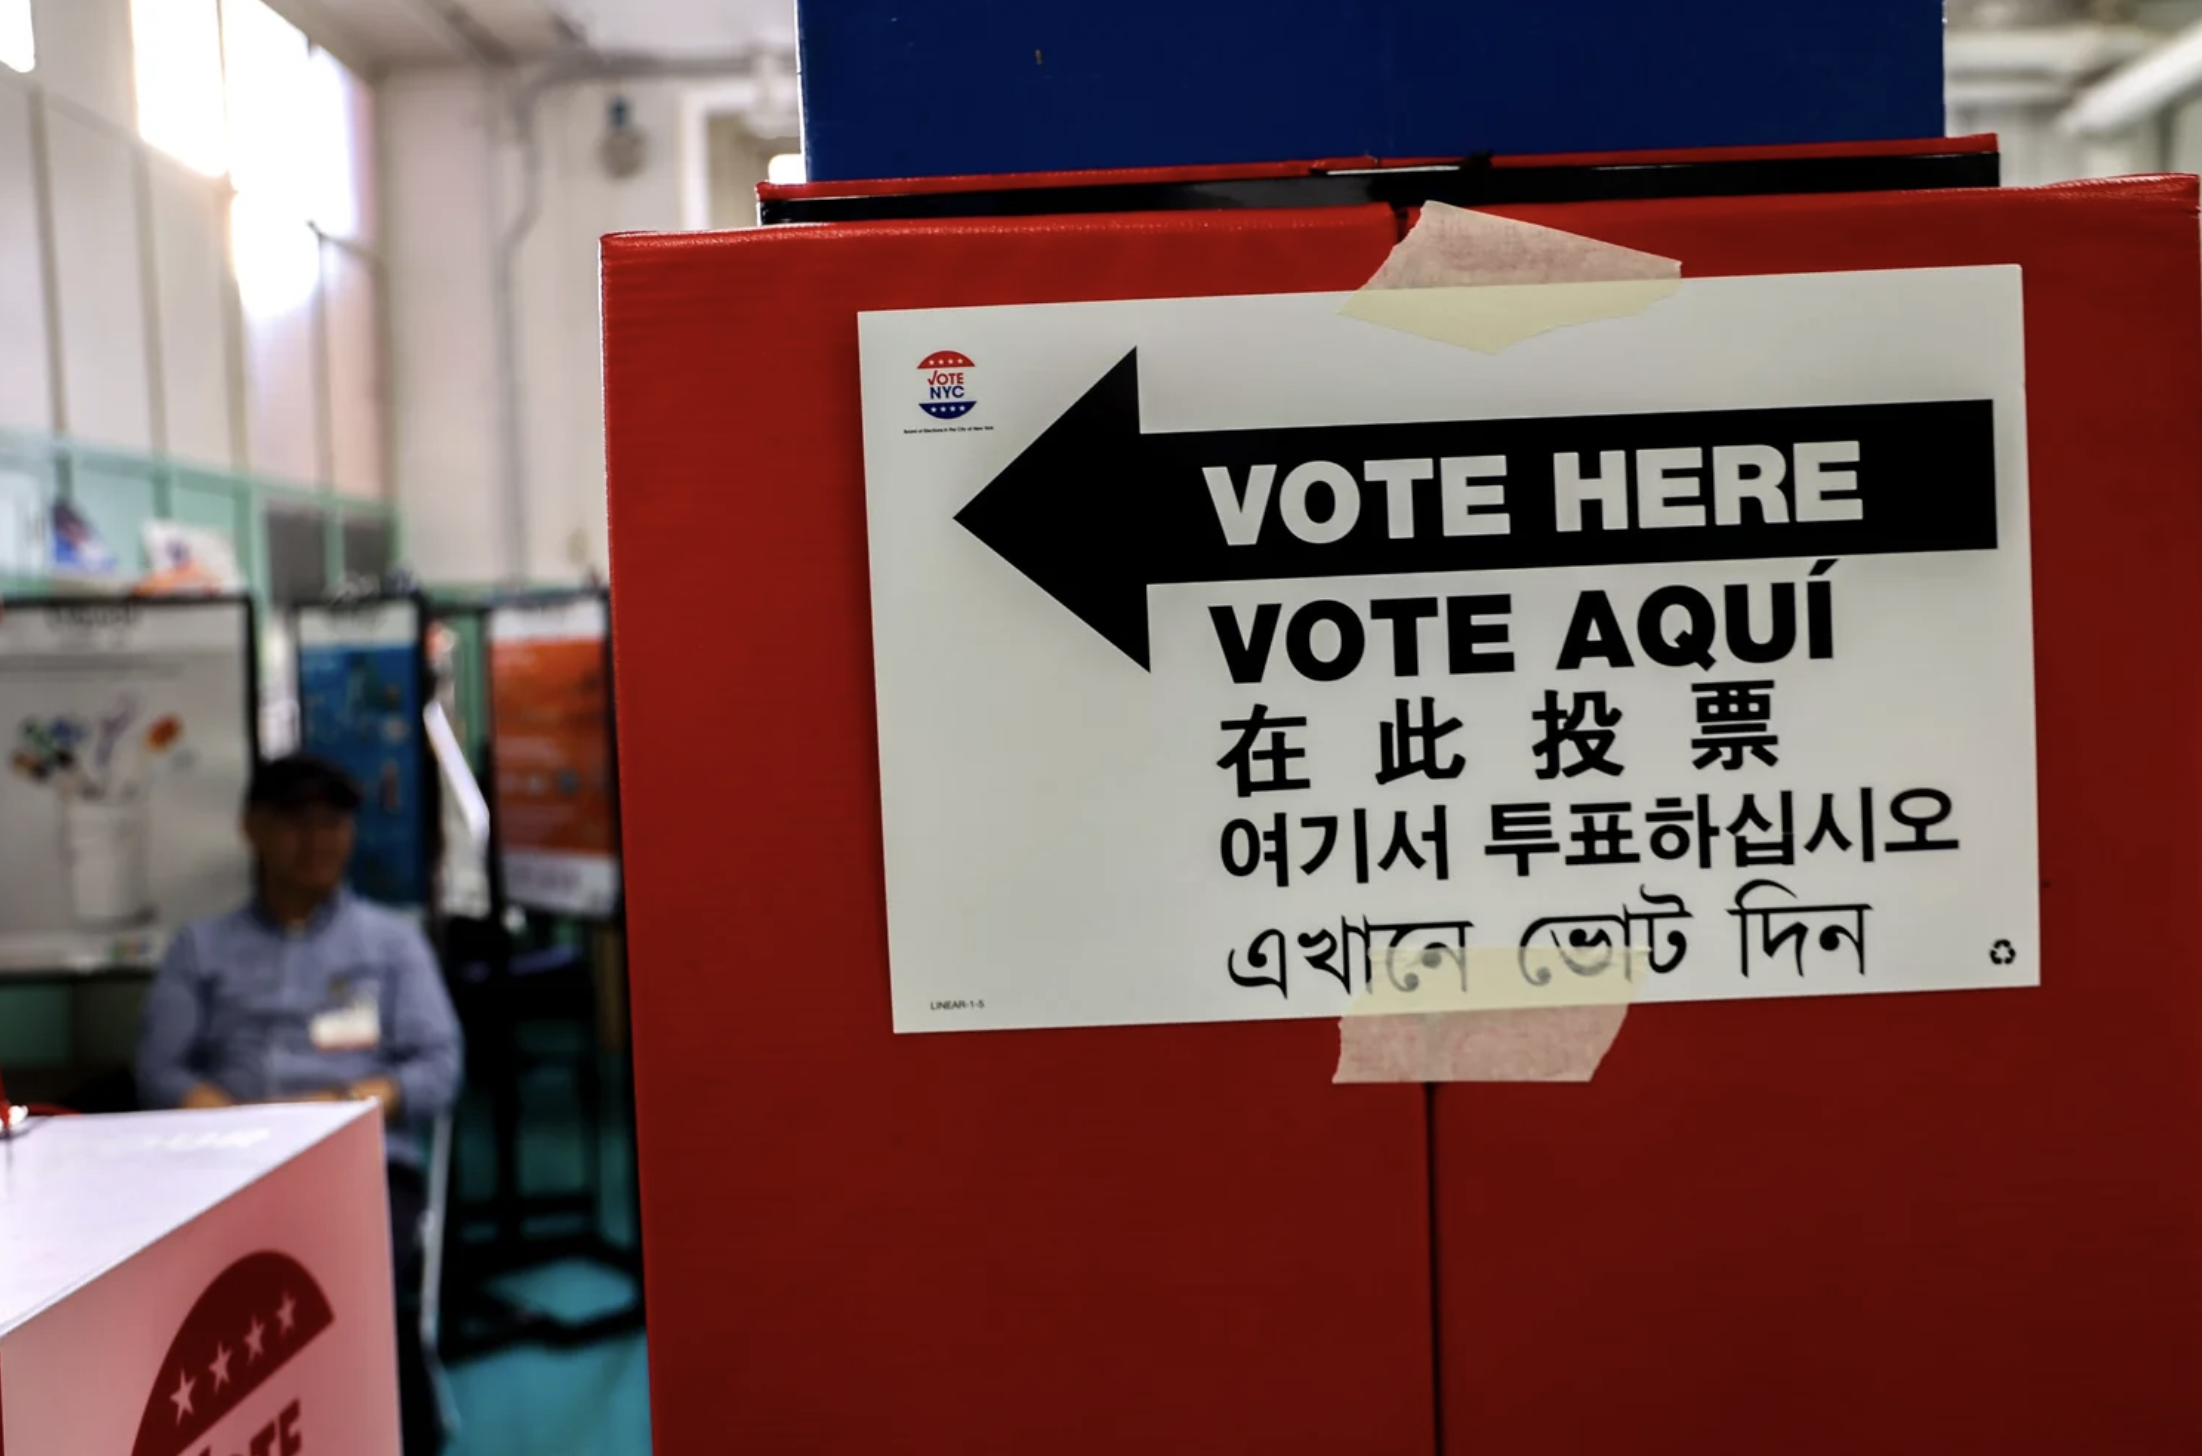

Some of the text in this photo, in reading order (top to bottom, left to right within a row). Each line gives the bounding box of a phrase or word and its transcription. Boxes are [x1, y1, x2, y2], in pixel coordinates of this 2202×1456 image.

[930, 386, 965, 399] NYC
[1202, 440, 1863, 546] VOTE HERE
[1208, 558, 1839, 684] VOTE AQUÍ
[1216, 679, 1780, 798] 在此投票
[1220, 786, 1960, 888] 여기서 투표하십시오
[1228, 878, 1873, 999] এখানে ভোট দিন
